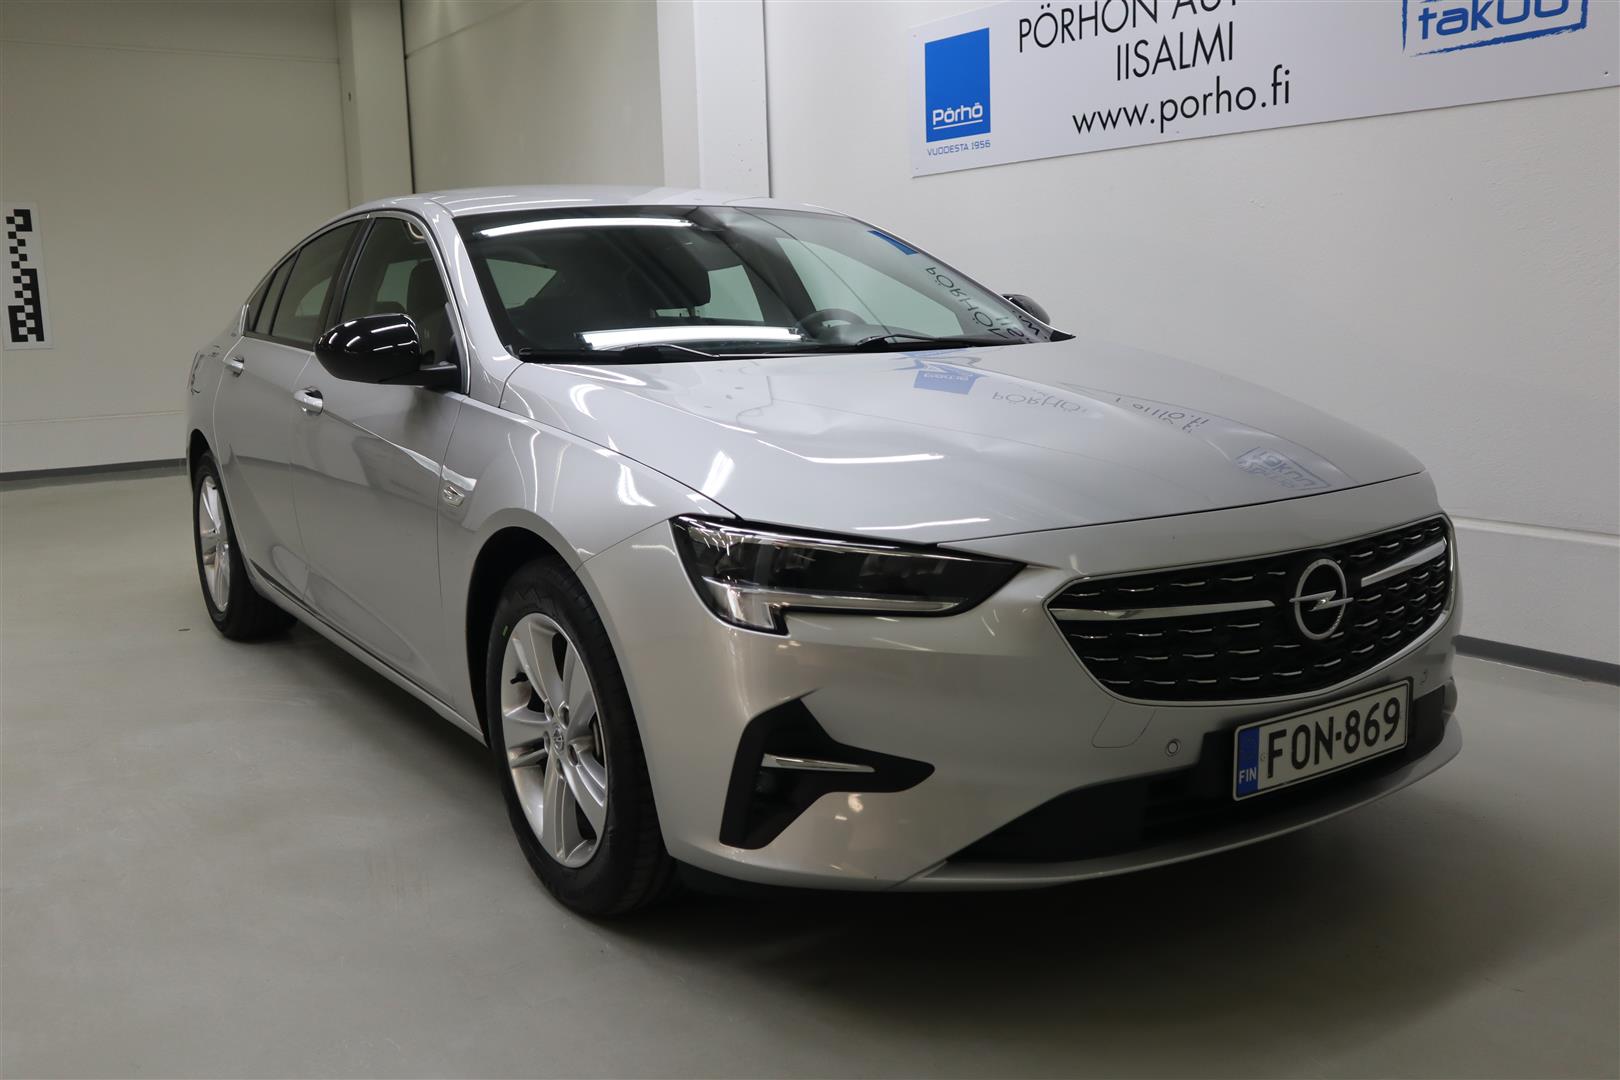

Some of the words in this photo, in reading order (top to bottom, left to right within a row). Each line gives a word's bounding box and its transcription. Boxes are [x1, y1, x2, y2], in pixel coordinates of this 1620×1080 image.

[1117, 21, 1234, 81] IISALMI
[932, 102, 983, 126] Pörhö
[1072, 64, 1290, 134] www.porho.fi
[927, 143, 969, 156] VUODESTA
[971, 139, 991, 150] 1956
[1267, 697, 1400, 779] FON-869
[1238, 766, 1257, 784] FIN
